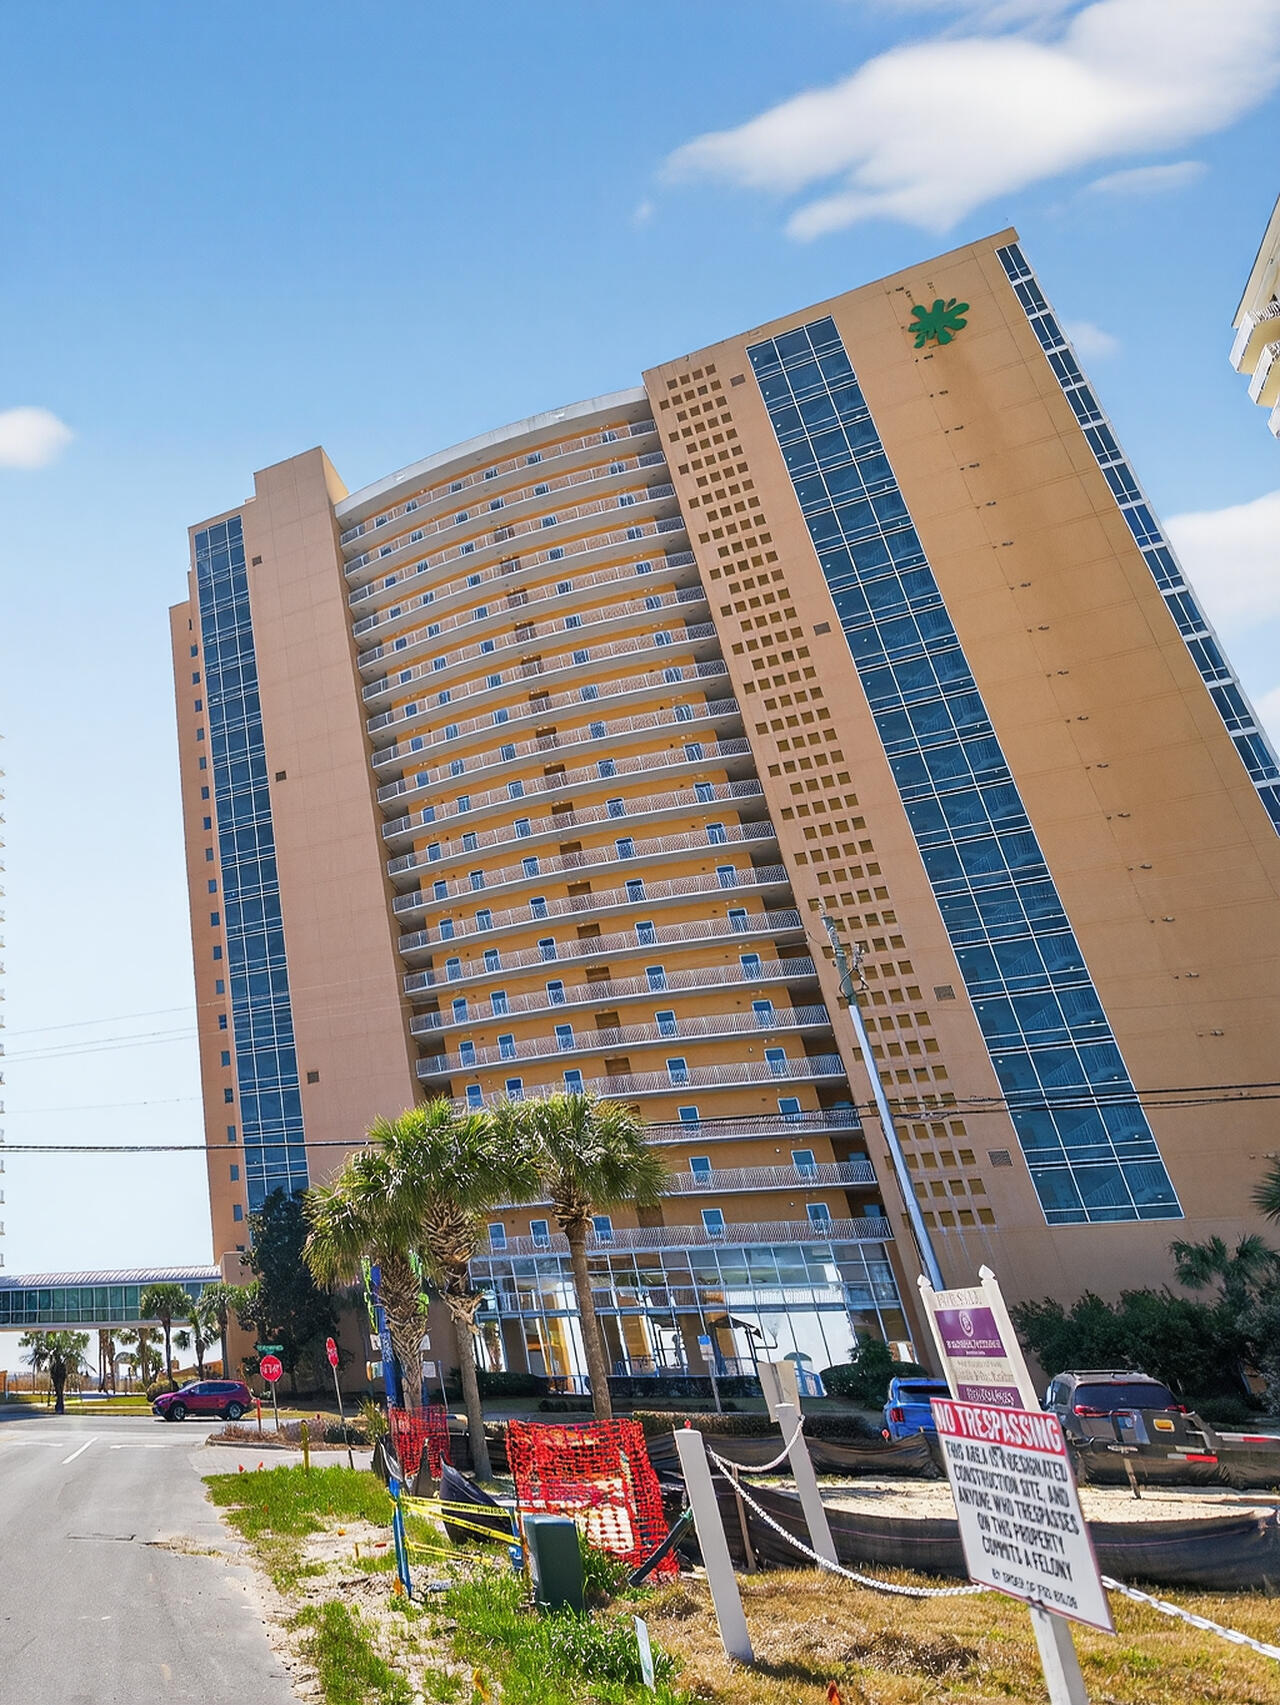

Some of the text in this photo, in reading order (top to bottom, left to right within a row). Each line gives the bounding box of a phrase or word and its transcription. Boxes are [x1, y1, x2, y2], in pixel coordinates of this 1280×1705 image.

[932, 1401, 1062, 1453] NO TRESPASSING
[945, 1440, 964, 1461] THIS
[965, 1445, 988, 1466] AREA
[1006, 1452, 1068, 1483] DESIGNATED
[953, 1463, 1020, 1495] CONSTRUCTION
[1047, 1485, 1070, 1507] AND
[958, 1486, 1080, 1535] ANYONE WHO TRESPASSES
[977, 1512, 1065, 1554] ON THIS PROPERTY
[982, 1535, 1073, 1582] COMMITS A FELONY
